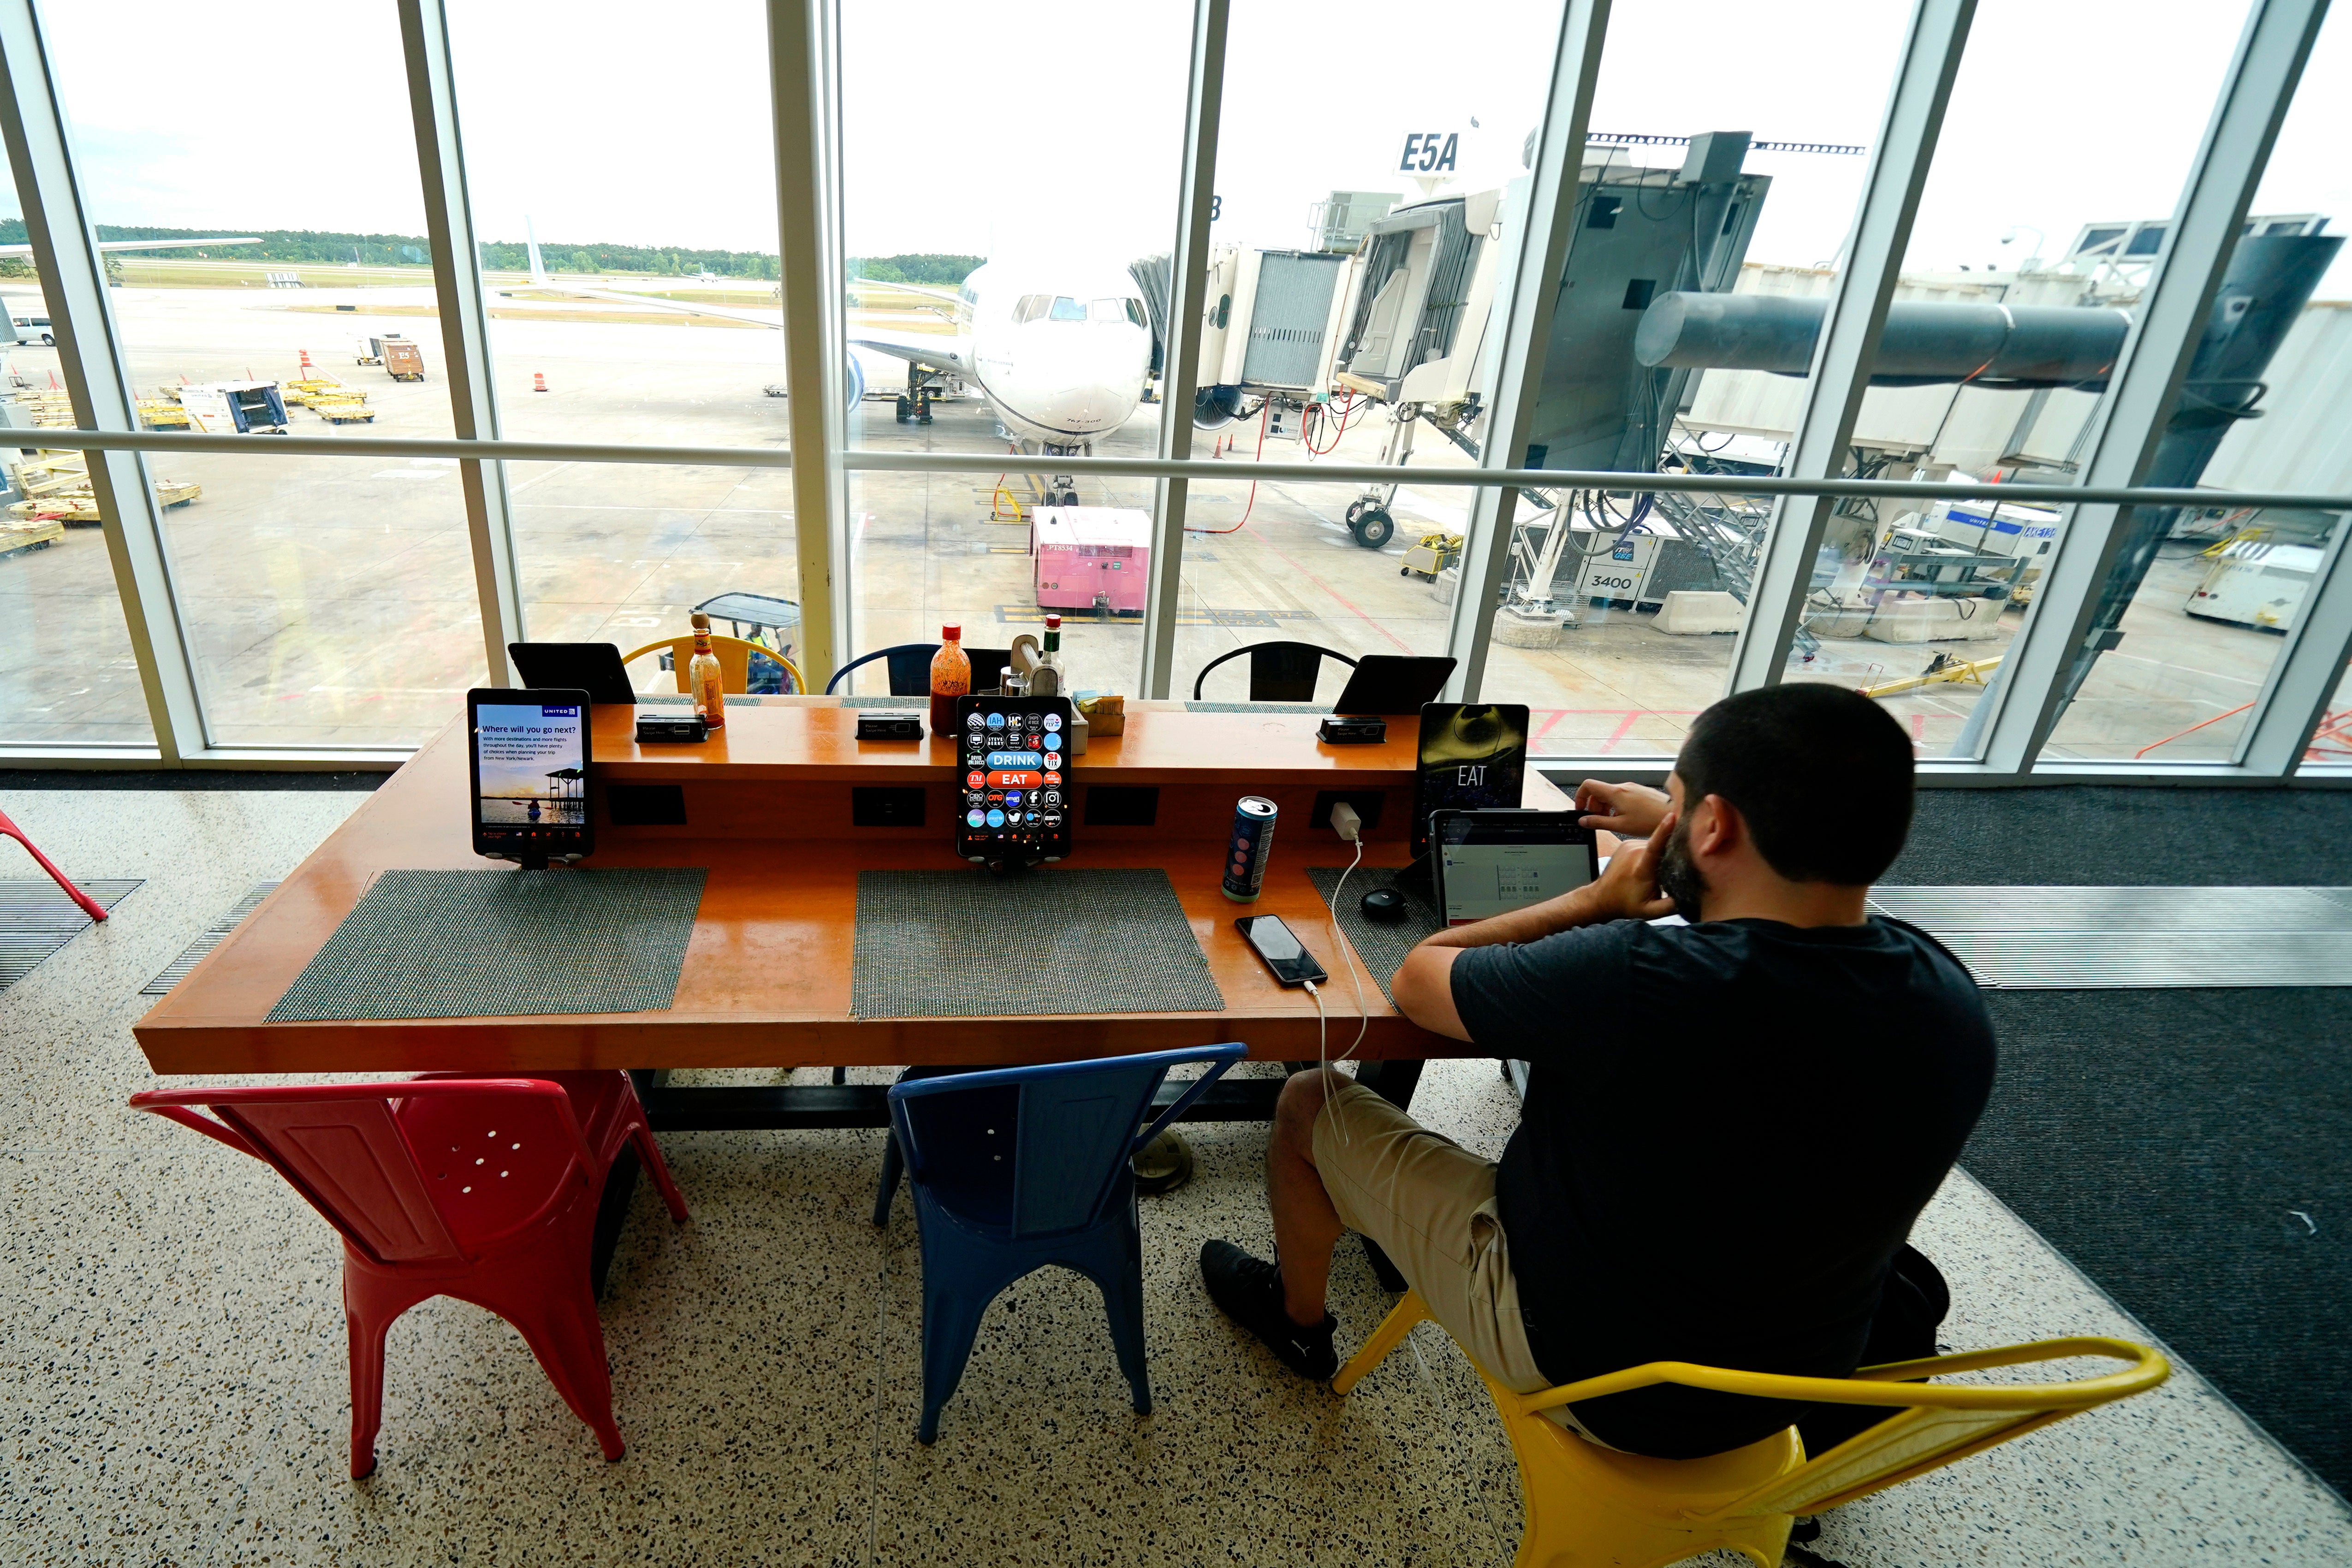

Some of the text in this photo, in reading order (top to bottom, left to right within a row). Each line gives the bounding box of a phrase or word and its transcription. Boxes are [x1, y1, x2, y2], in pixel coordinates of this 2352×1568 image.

[1400, 133, 1458, 171] E5A
[1592, 576, 1632, 589] 3400
[1008, 716, 1022, 726] HC
[994, 755, 1036, 765] DRINK
[1002, 774, 1028, 784] EAT
[1458, 765, 1487, 786] EAT
